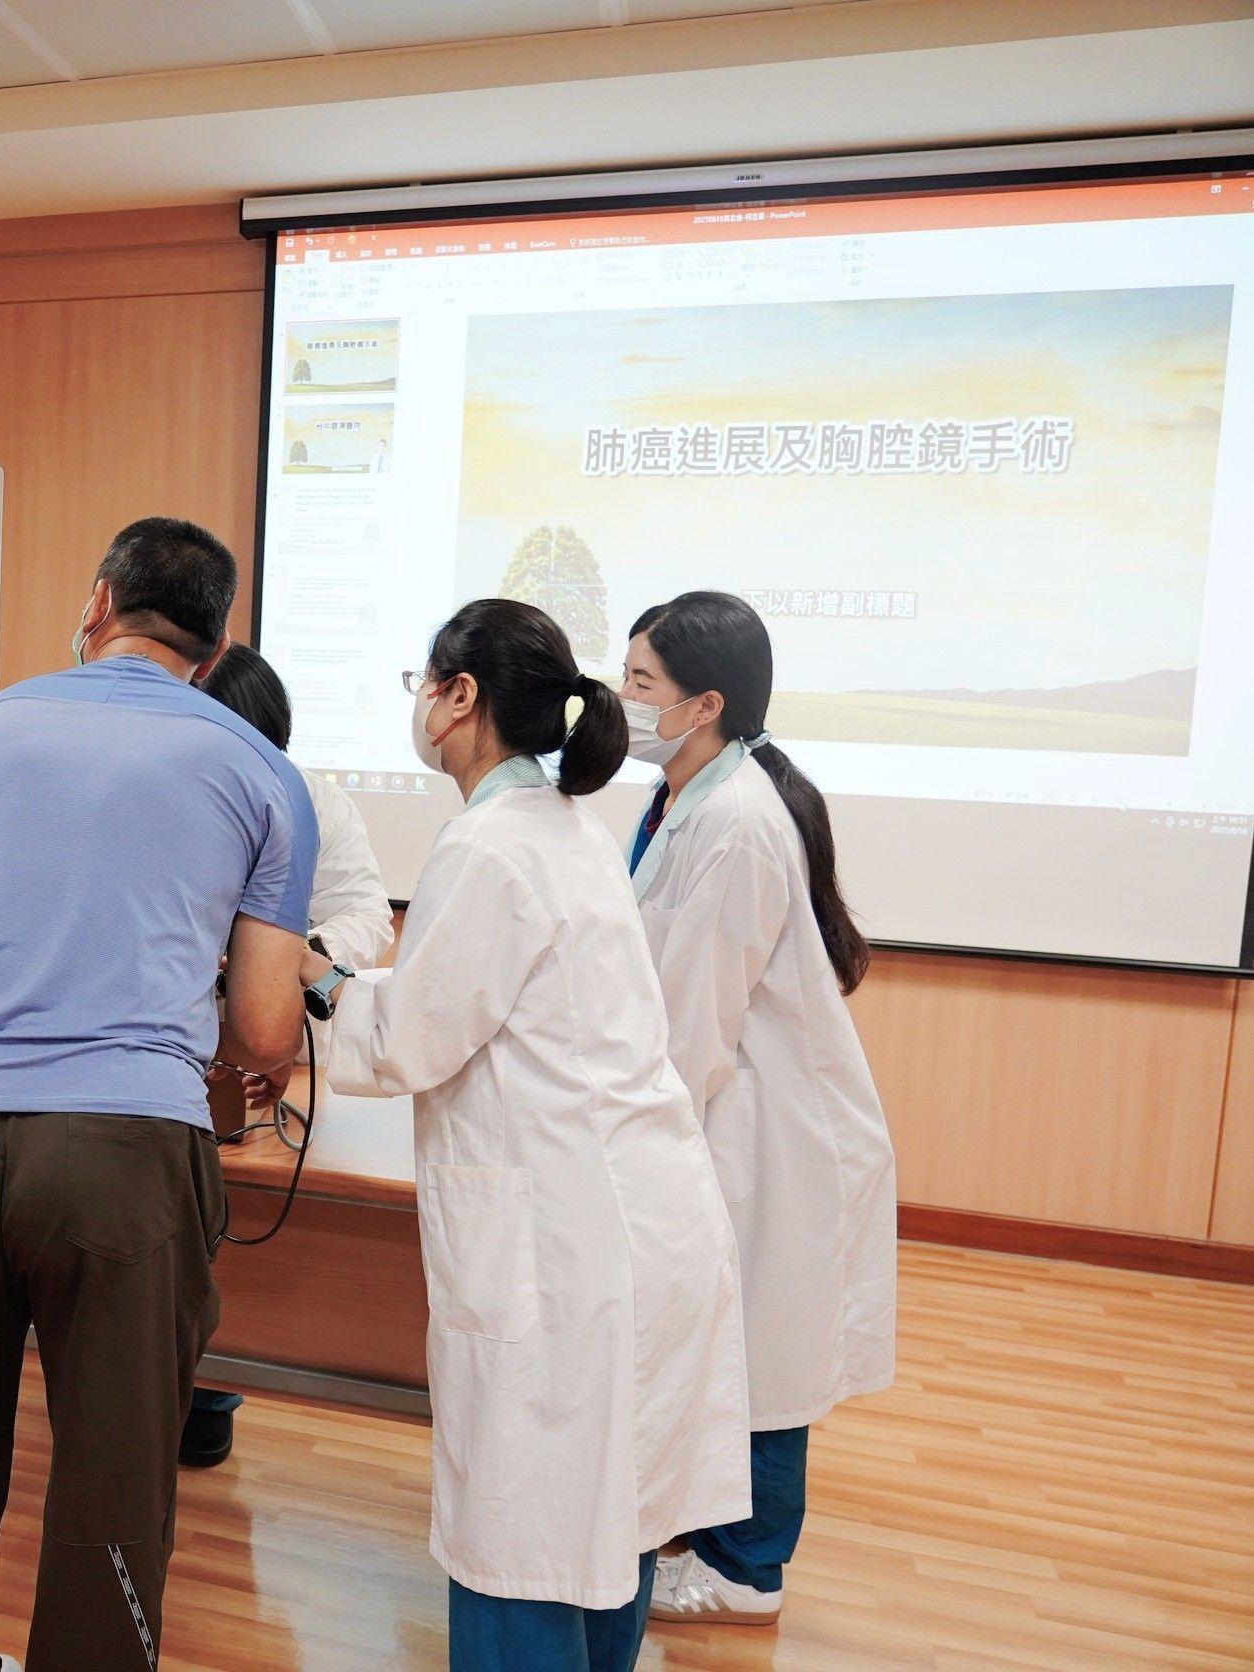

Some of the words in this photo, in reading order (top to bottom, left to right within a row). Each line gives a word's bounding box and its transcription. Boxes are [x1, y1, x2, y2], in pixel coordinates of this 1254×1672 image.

[770, 211, 806, 220] PowerPoint
[583, 418, 1074, 474] 肺癌進展及胸腔鏡手術
